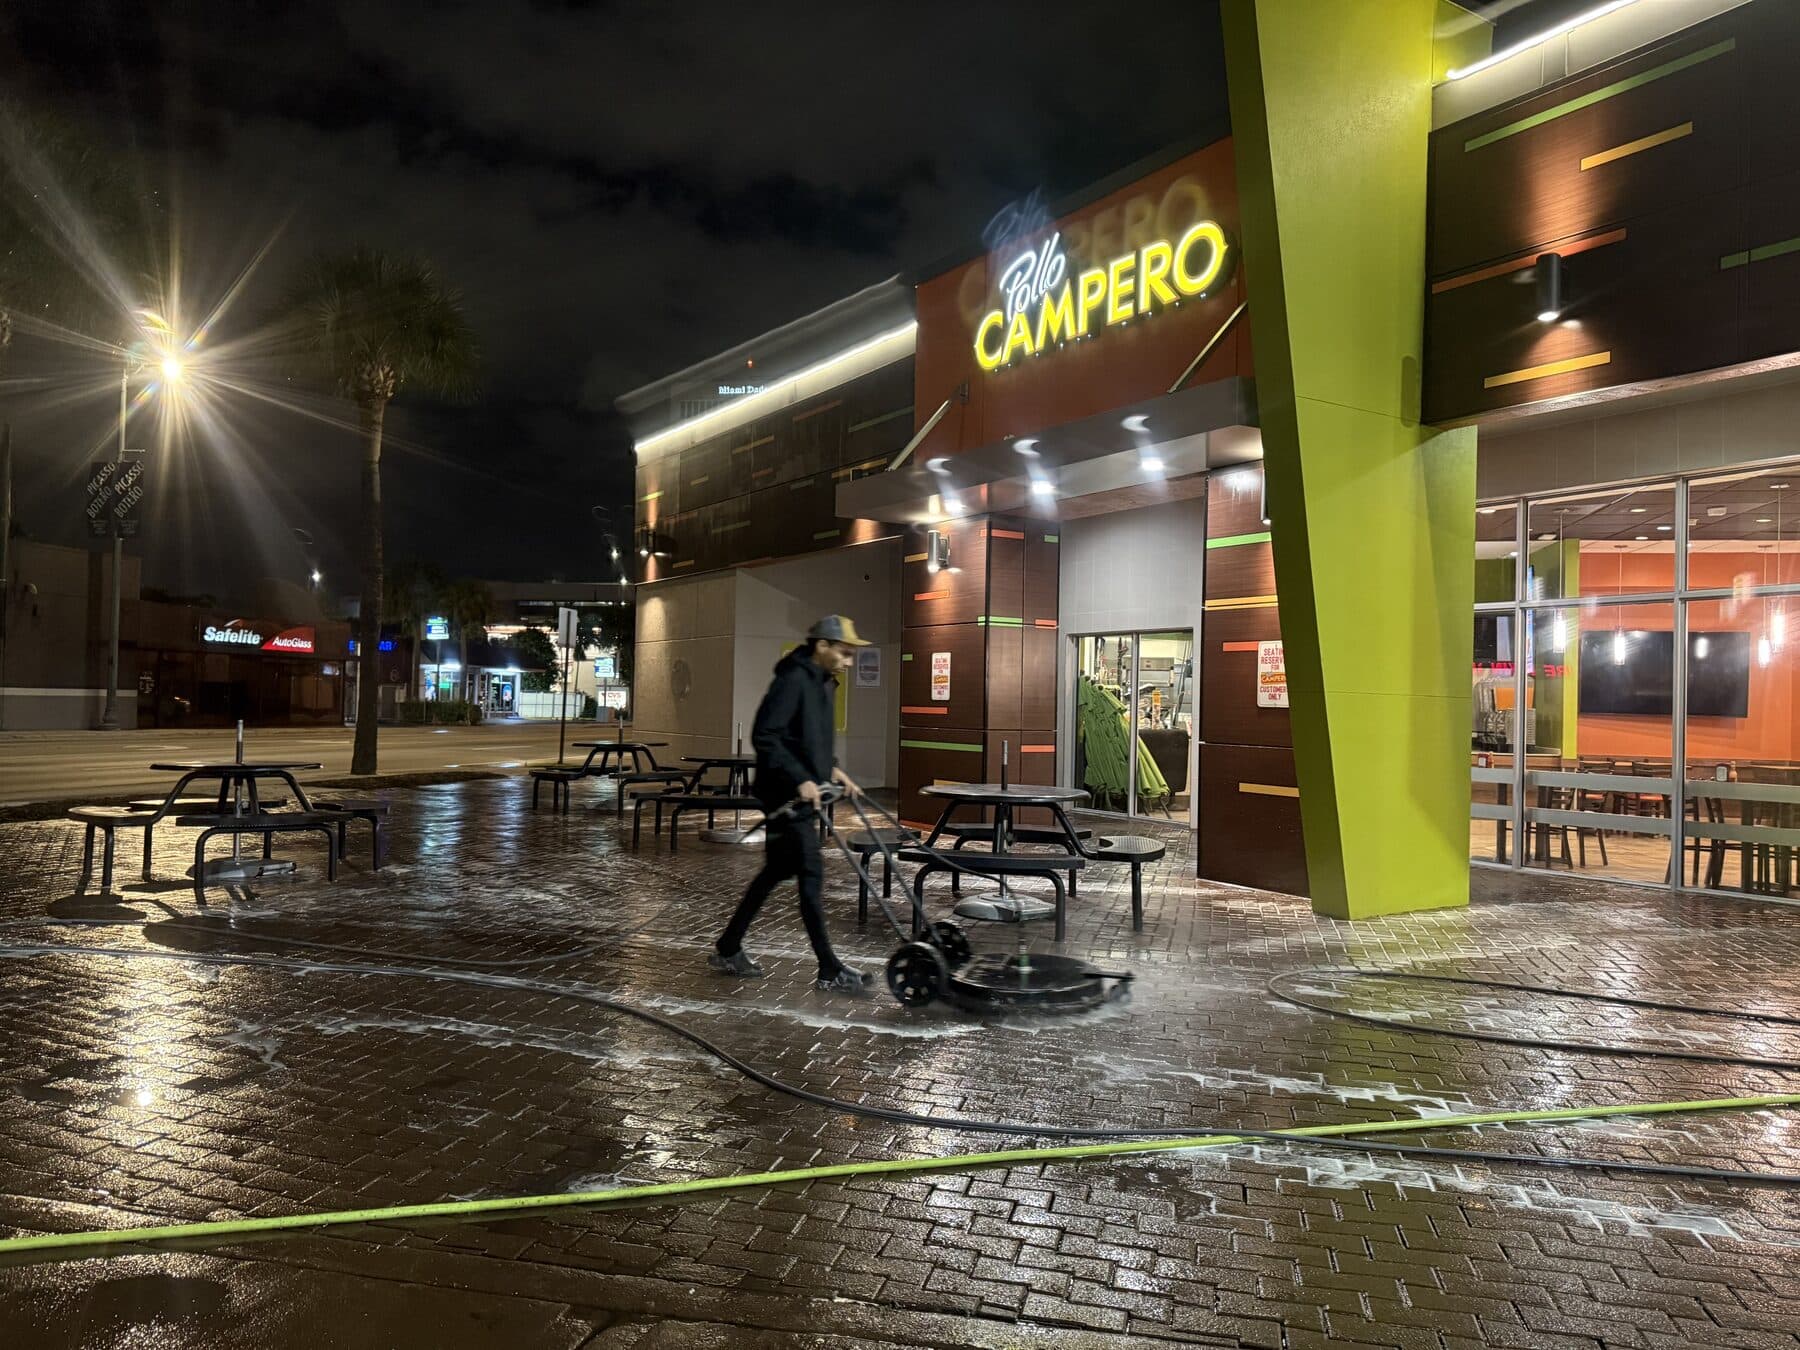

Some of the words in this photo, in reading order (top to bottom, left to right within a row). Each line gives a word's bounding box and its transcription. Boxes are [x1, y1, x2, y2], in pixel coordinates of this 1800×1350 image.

[1000, 232, 1066, 322] Pollo
[974, 221, 1229, 370] CAMPERO
[718, 386, 746, 394] Miami
[114, 460, 144, 495] PICASSO
[113, 486, 143, 518] BOTERO
[203, 626, 260, 644] Safelite
[272, 636, 313, 648] AutoGlass
[1260, 656, 1284, 664] RESERV
[1263, 647, 1284, 656] SEATI
[1260, 685, 1287, 693] CUSTOMER
